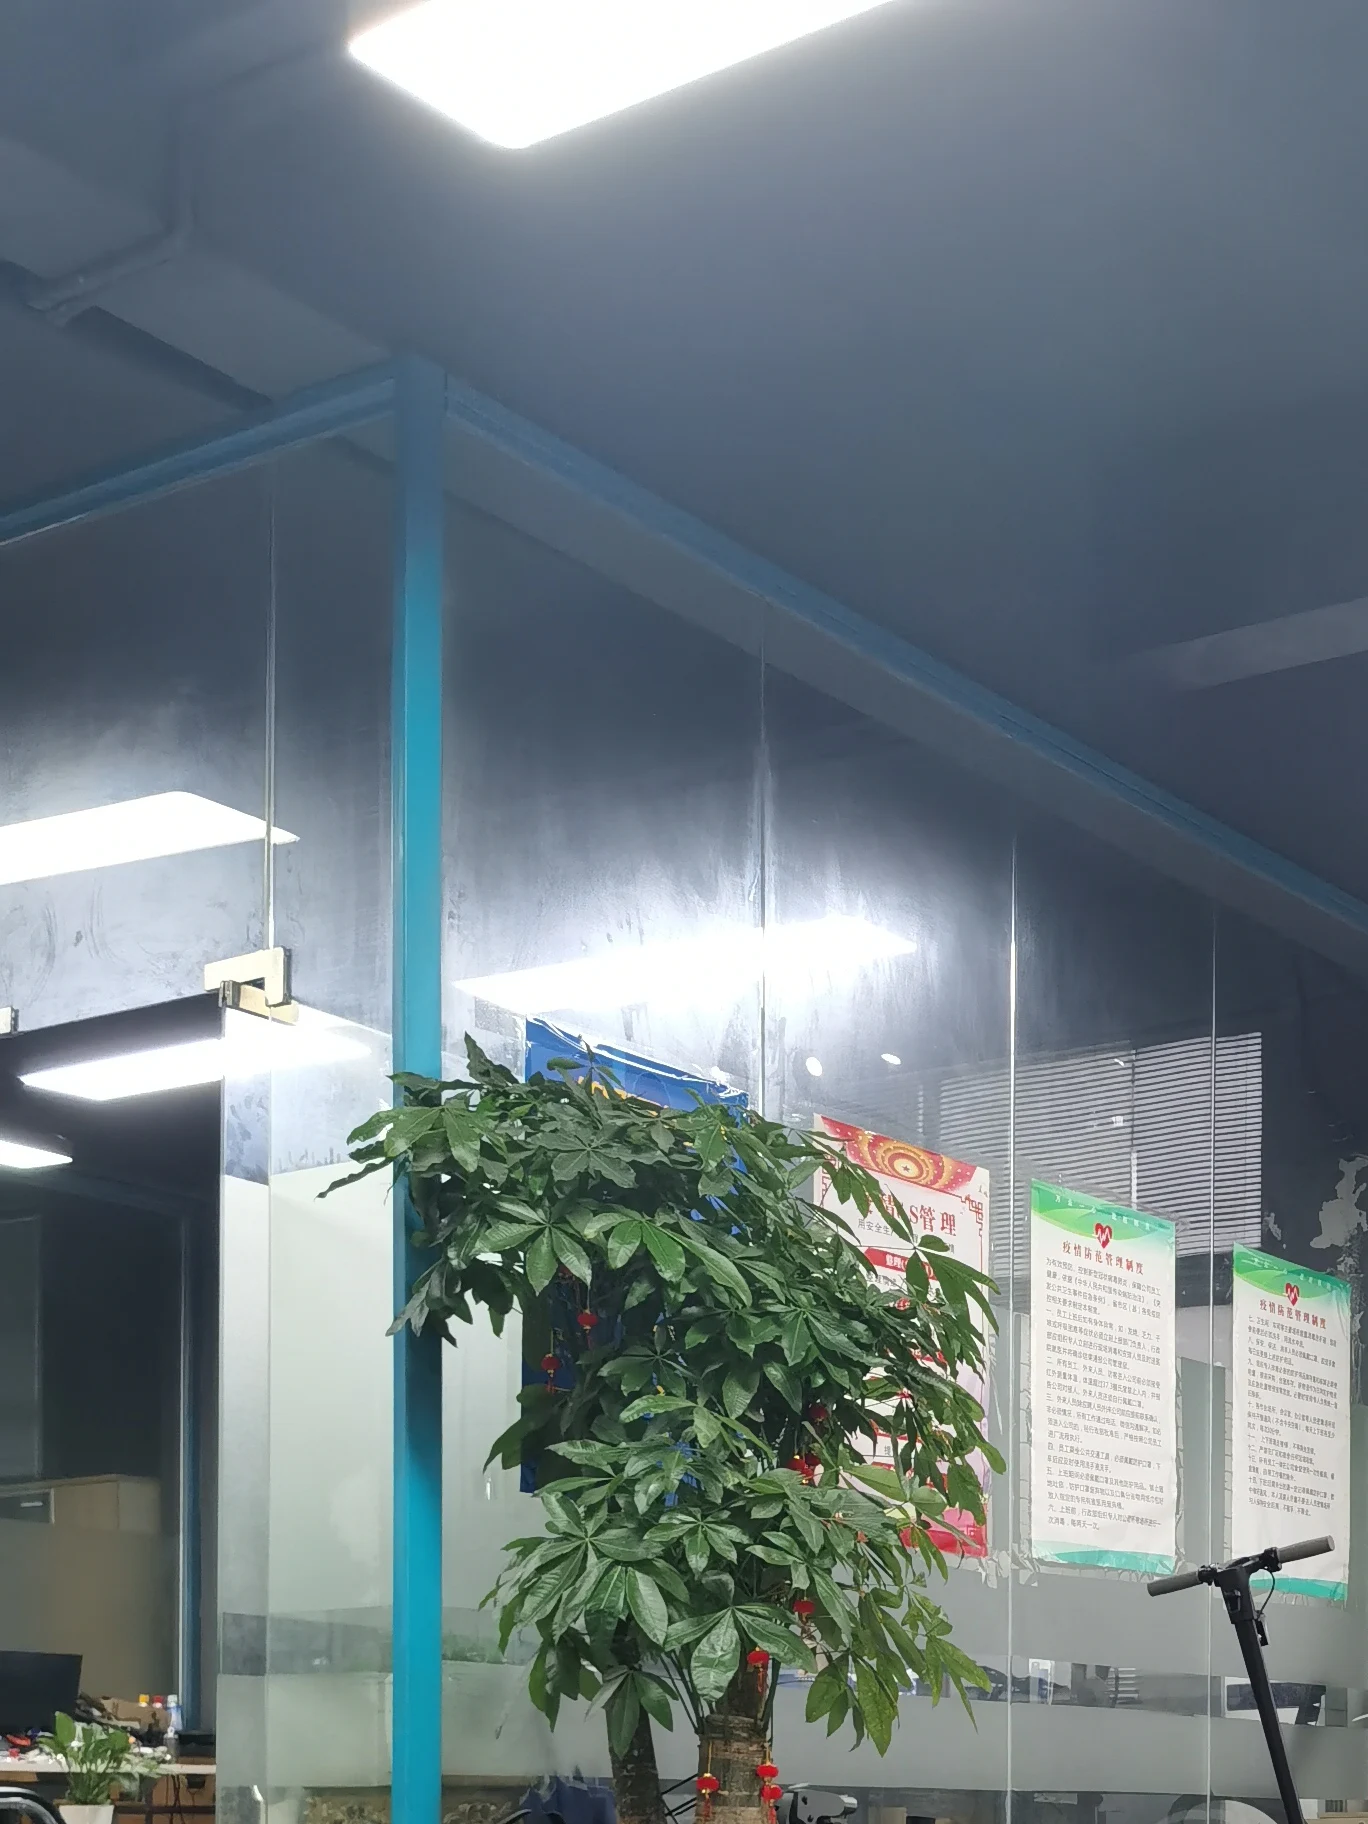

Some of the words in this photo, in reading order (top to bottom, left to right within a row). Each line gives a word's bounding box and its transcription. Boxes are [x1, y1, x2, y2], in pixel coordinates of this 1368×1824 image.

[1061, 1238, 1144, 1276] 疫情防范管理制度
